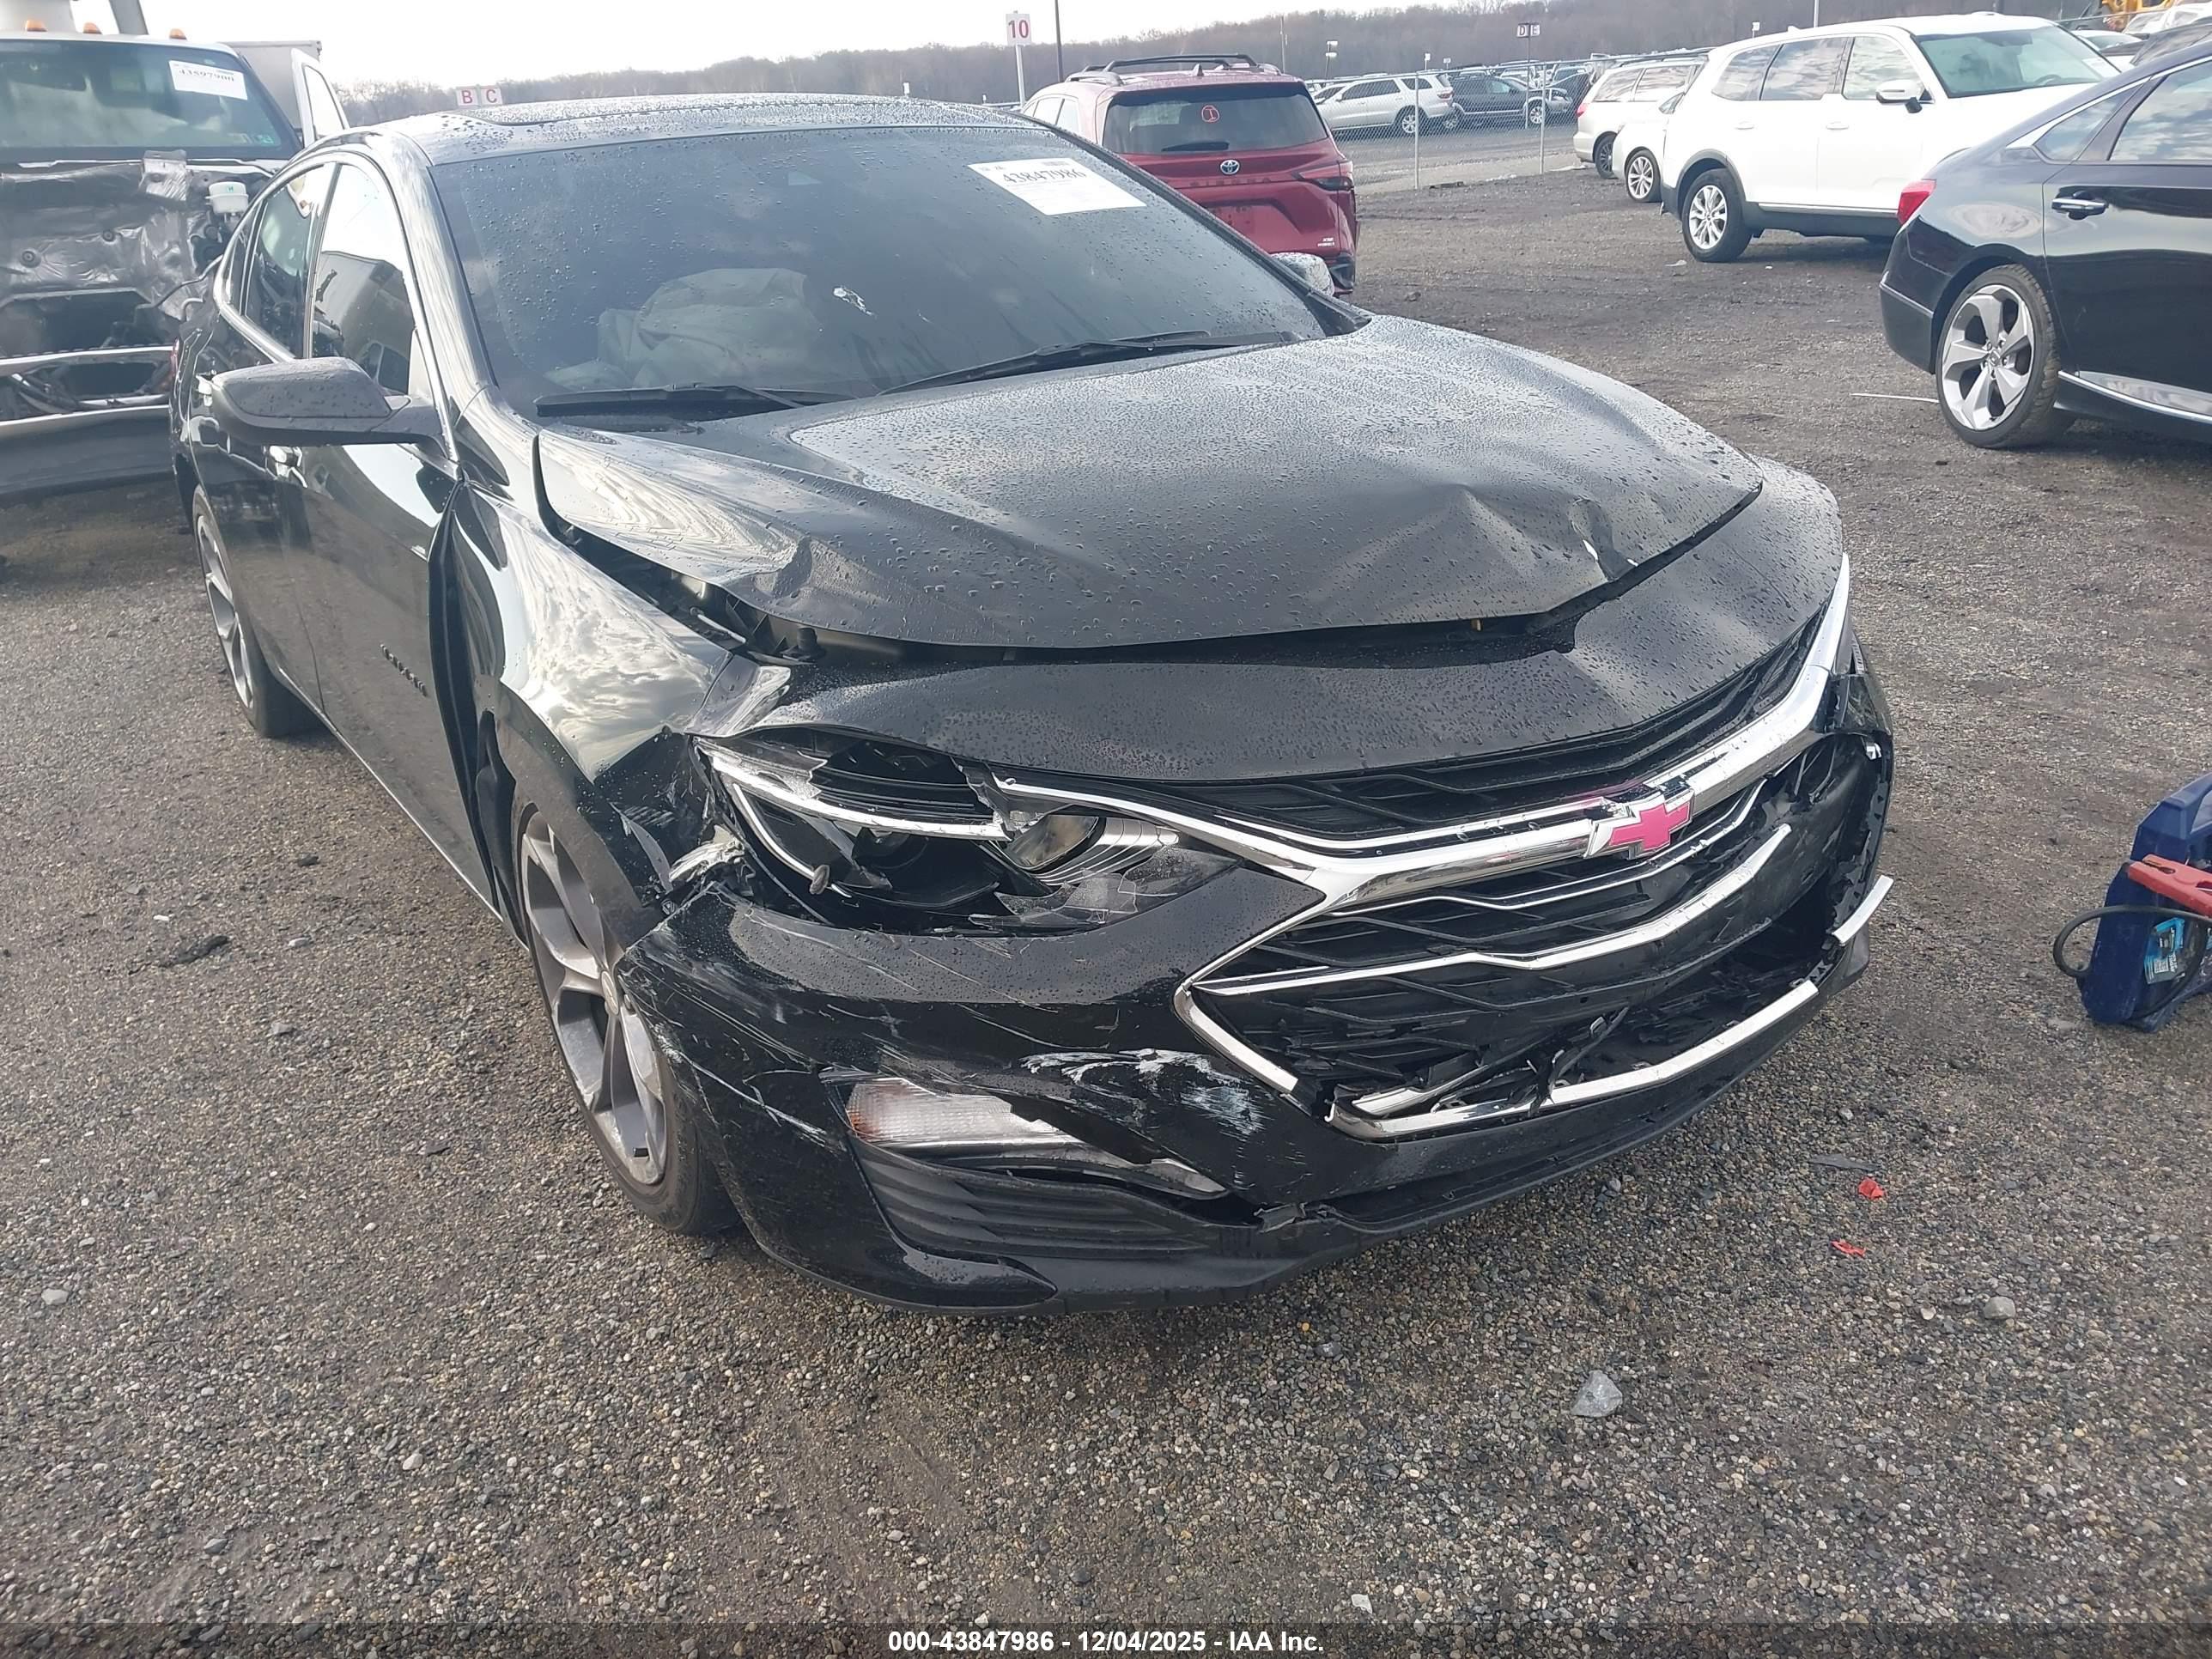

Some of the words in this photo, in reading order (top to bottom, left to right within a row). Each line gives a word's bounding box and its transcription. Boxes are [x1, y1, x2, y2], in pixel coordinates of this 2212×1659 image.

[1008, 20, 1029, 39] 10
[461, 89, 473, 104] B
[486, 88, 497, 103] C
[1003, 168, 1086, 183] 43847986
